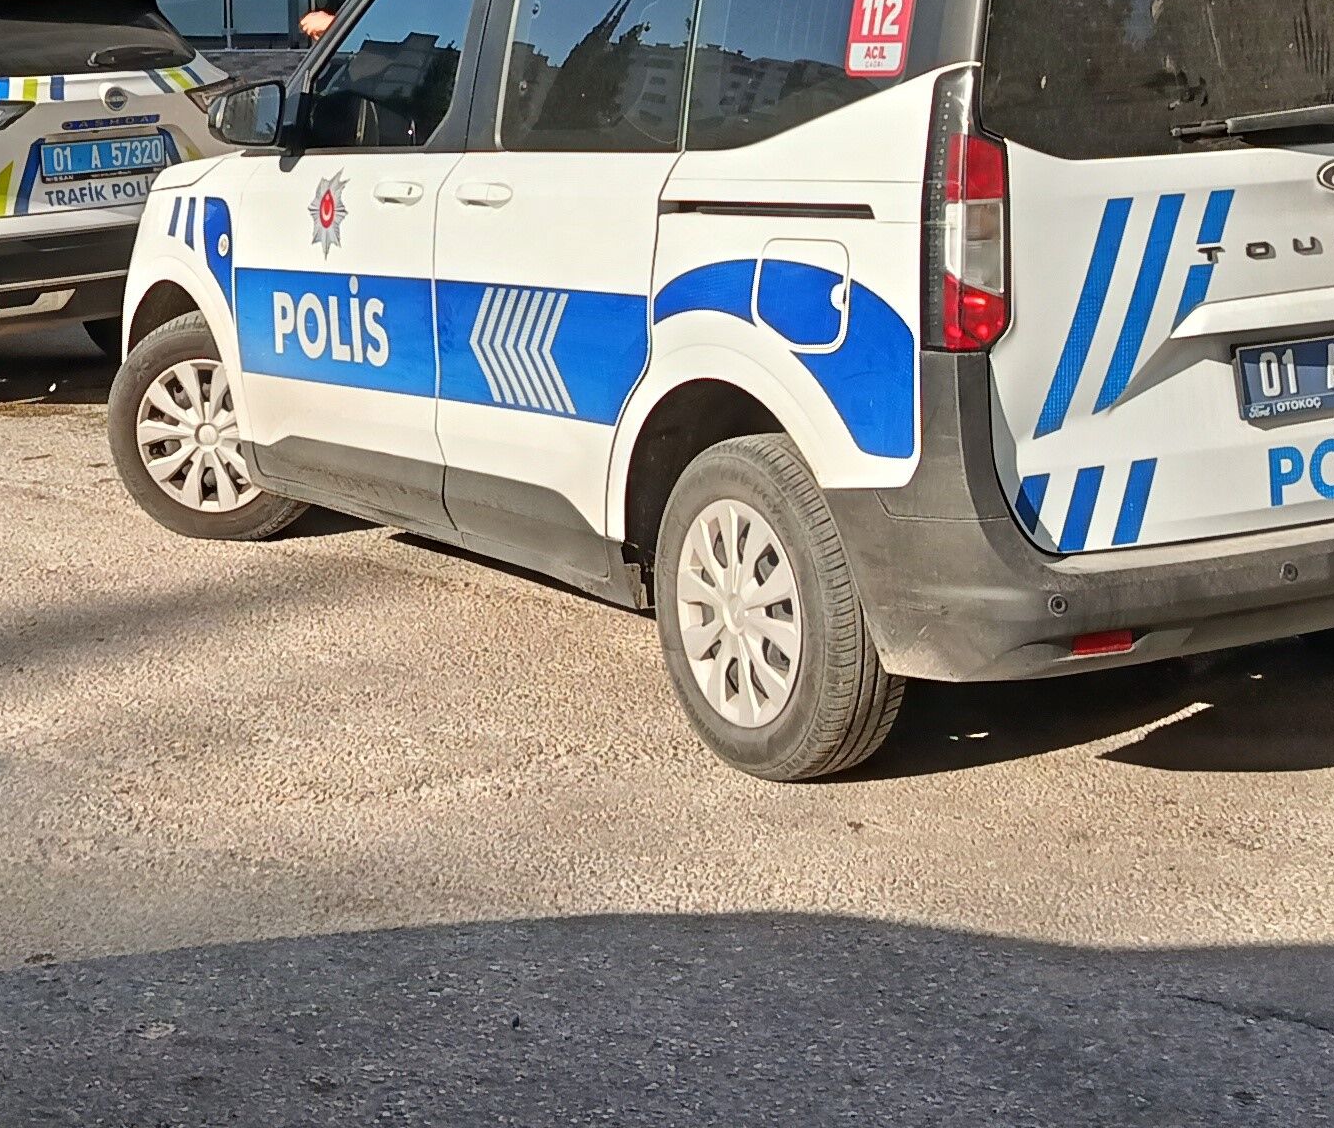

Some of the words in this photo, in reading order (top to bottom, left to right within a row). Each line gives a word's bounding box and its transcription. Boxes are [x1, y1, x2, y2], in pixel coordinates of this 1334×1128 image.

[53, 147, 72, 172] 01
[91, 144, 102, 169] A
[111, 140, 162, 166] 57320
[45, 182, 107, 207] TRAFİK
[273, 275, 389, 368] POLİS
[1259, 348, 1298, 397] 01
[1277, 397, 1322, 413] OTOKOÇ
